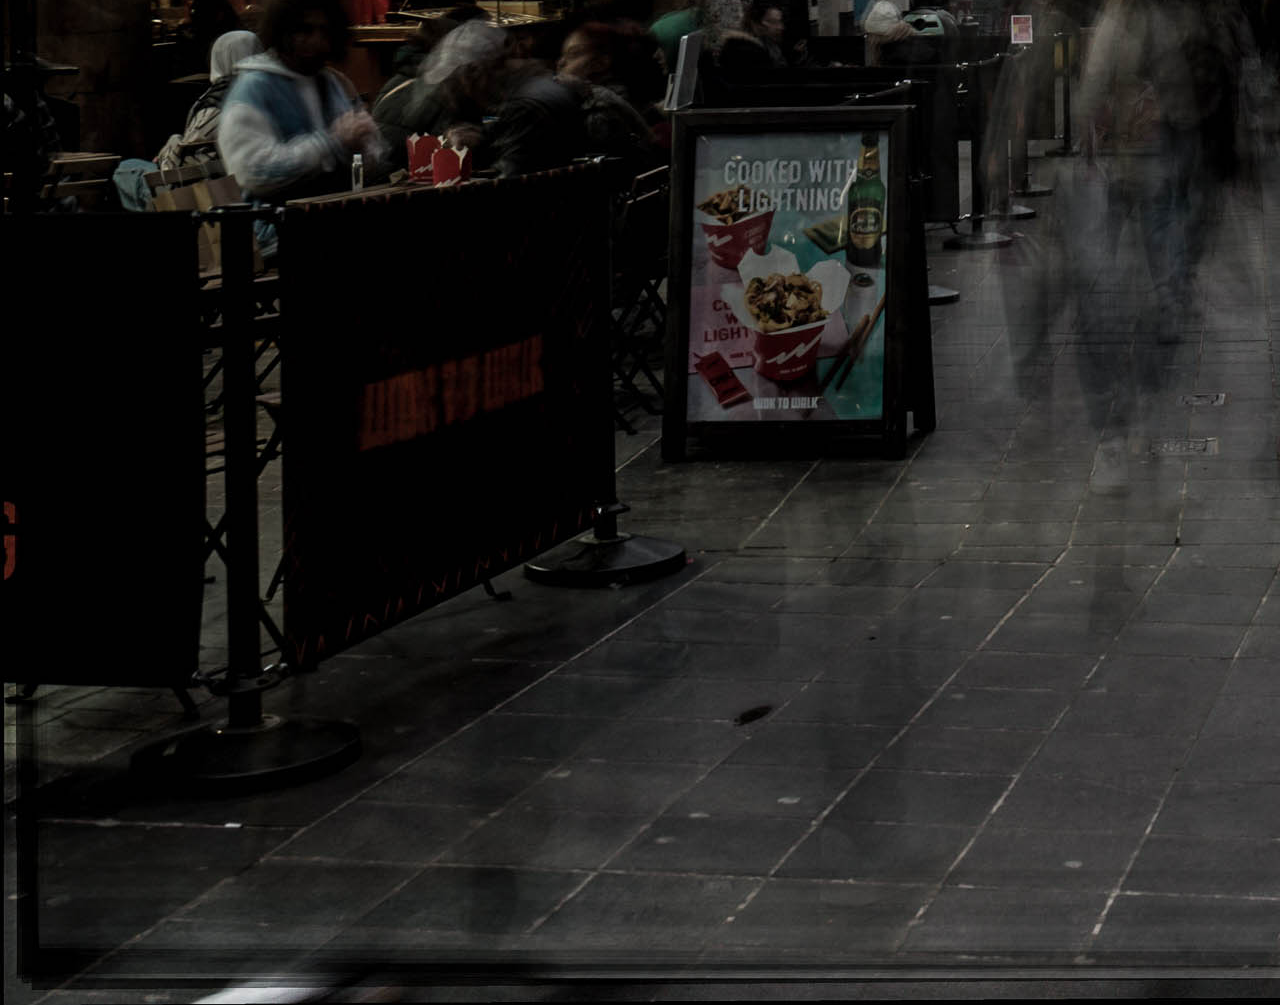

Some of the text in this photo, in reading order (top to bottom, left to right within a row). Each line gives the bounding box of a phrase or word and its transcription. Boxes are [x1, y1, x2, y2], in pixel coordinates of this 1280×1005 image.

[724, 159, 858, 185] COOKED WITH
[738, 187, 842, 213] LIGHTNING
[753, 396, 820, 410] WOK TO WALK
